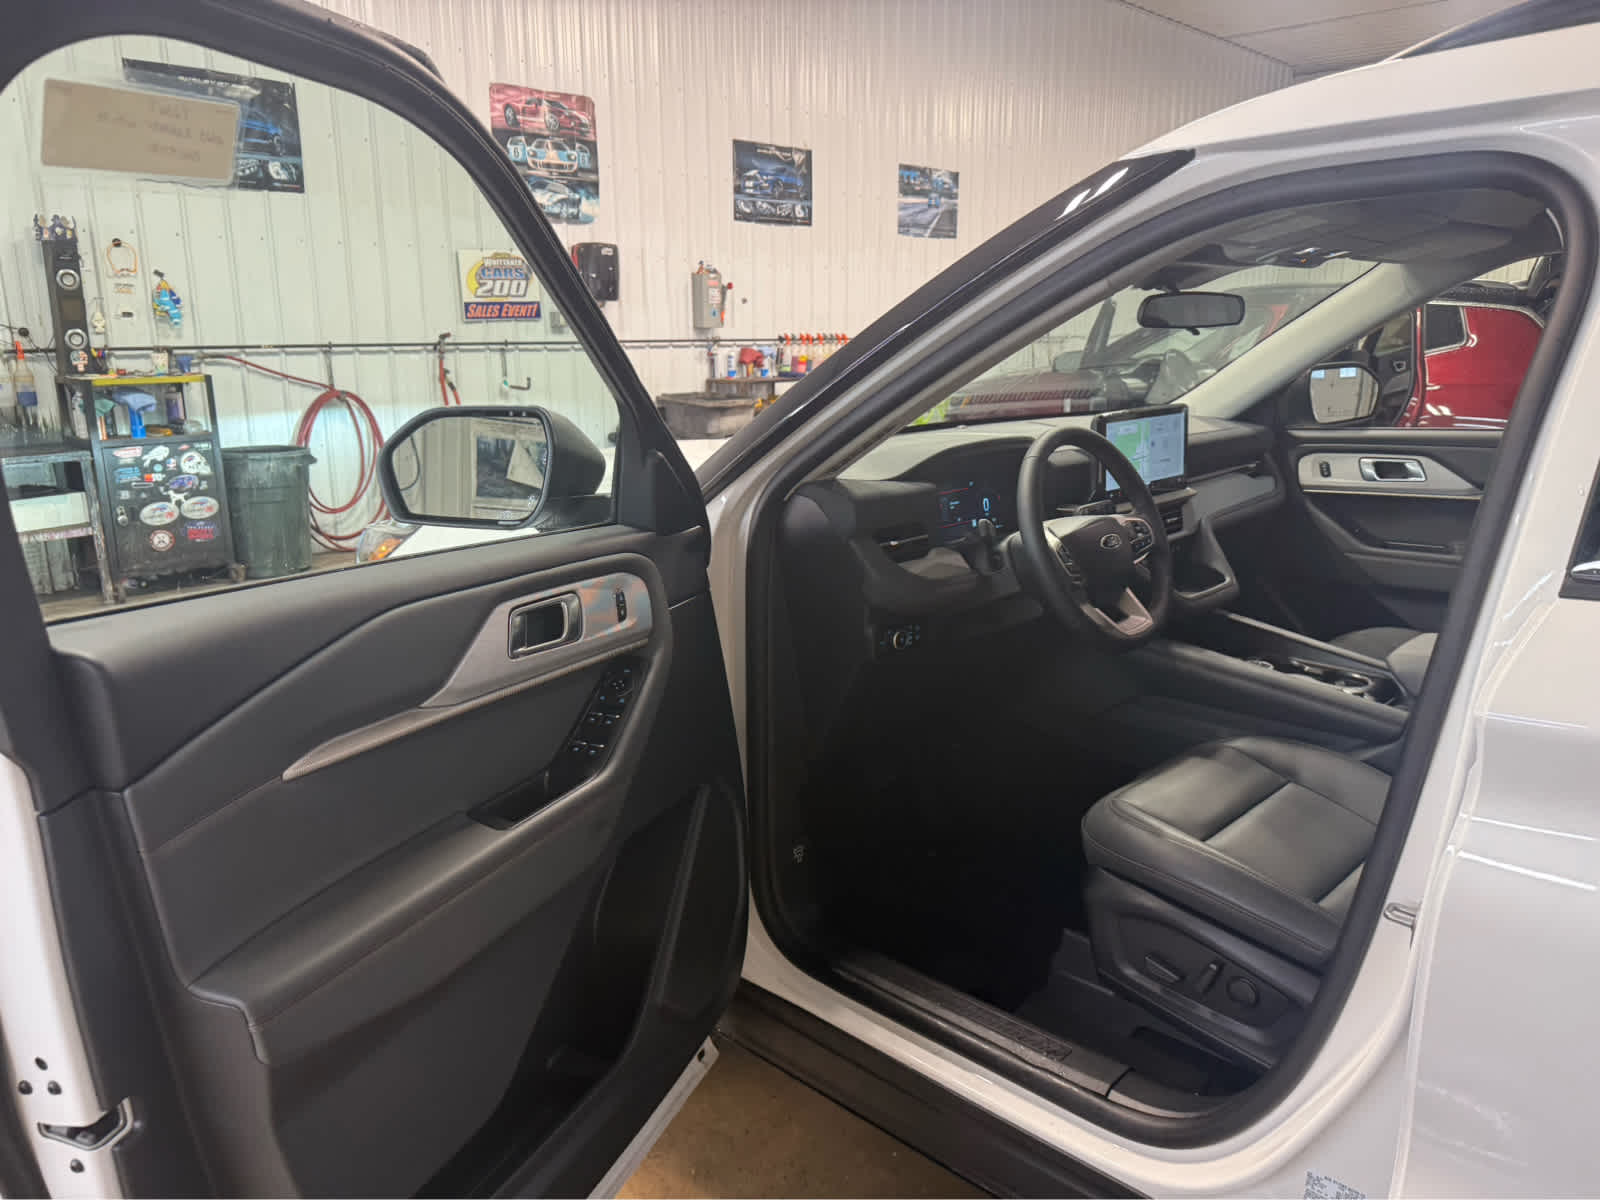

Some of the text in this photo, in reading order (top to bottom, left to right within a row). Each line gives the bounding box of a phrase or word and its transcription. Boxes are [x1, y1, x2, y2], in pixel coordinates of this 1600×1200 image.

[481, 267, 525, 279] CARS
[476, 279, 527, 296] 200
[467, 303, 538, 318] SALES EVENT!
[983, 497, 990, 512] 0
